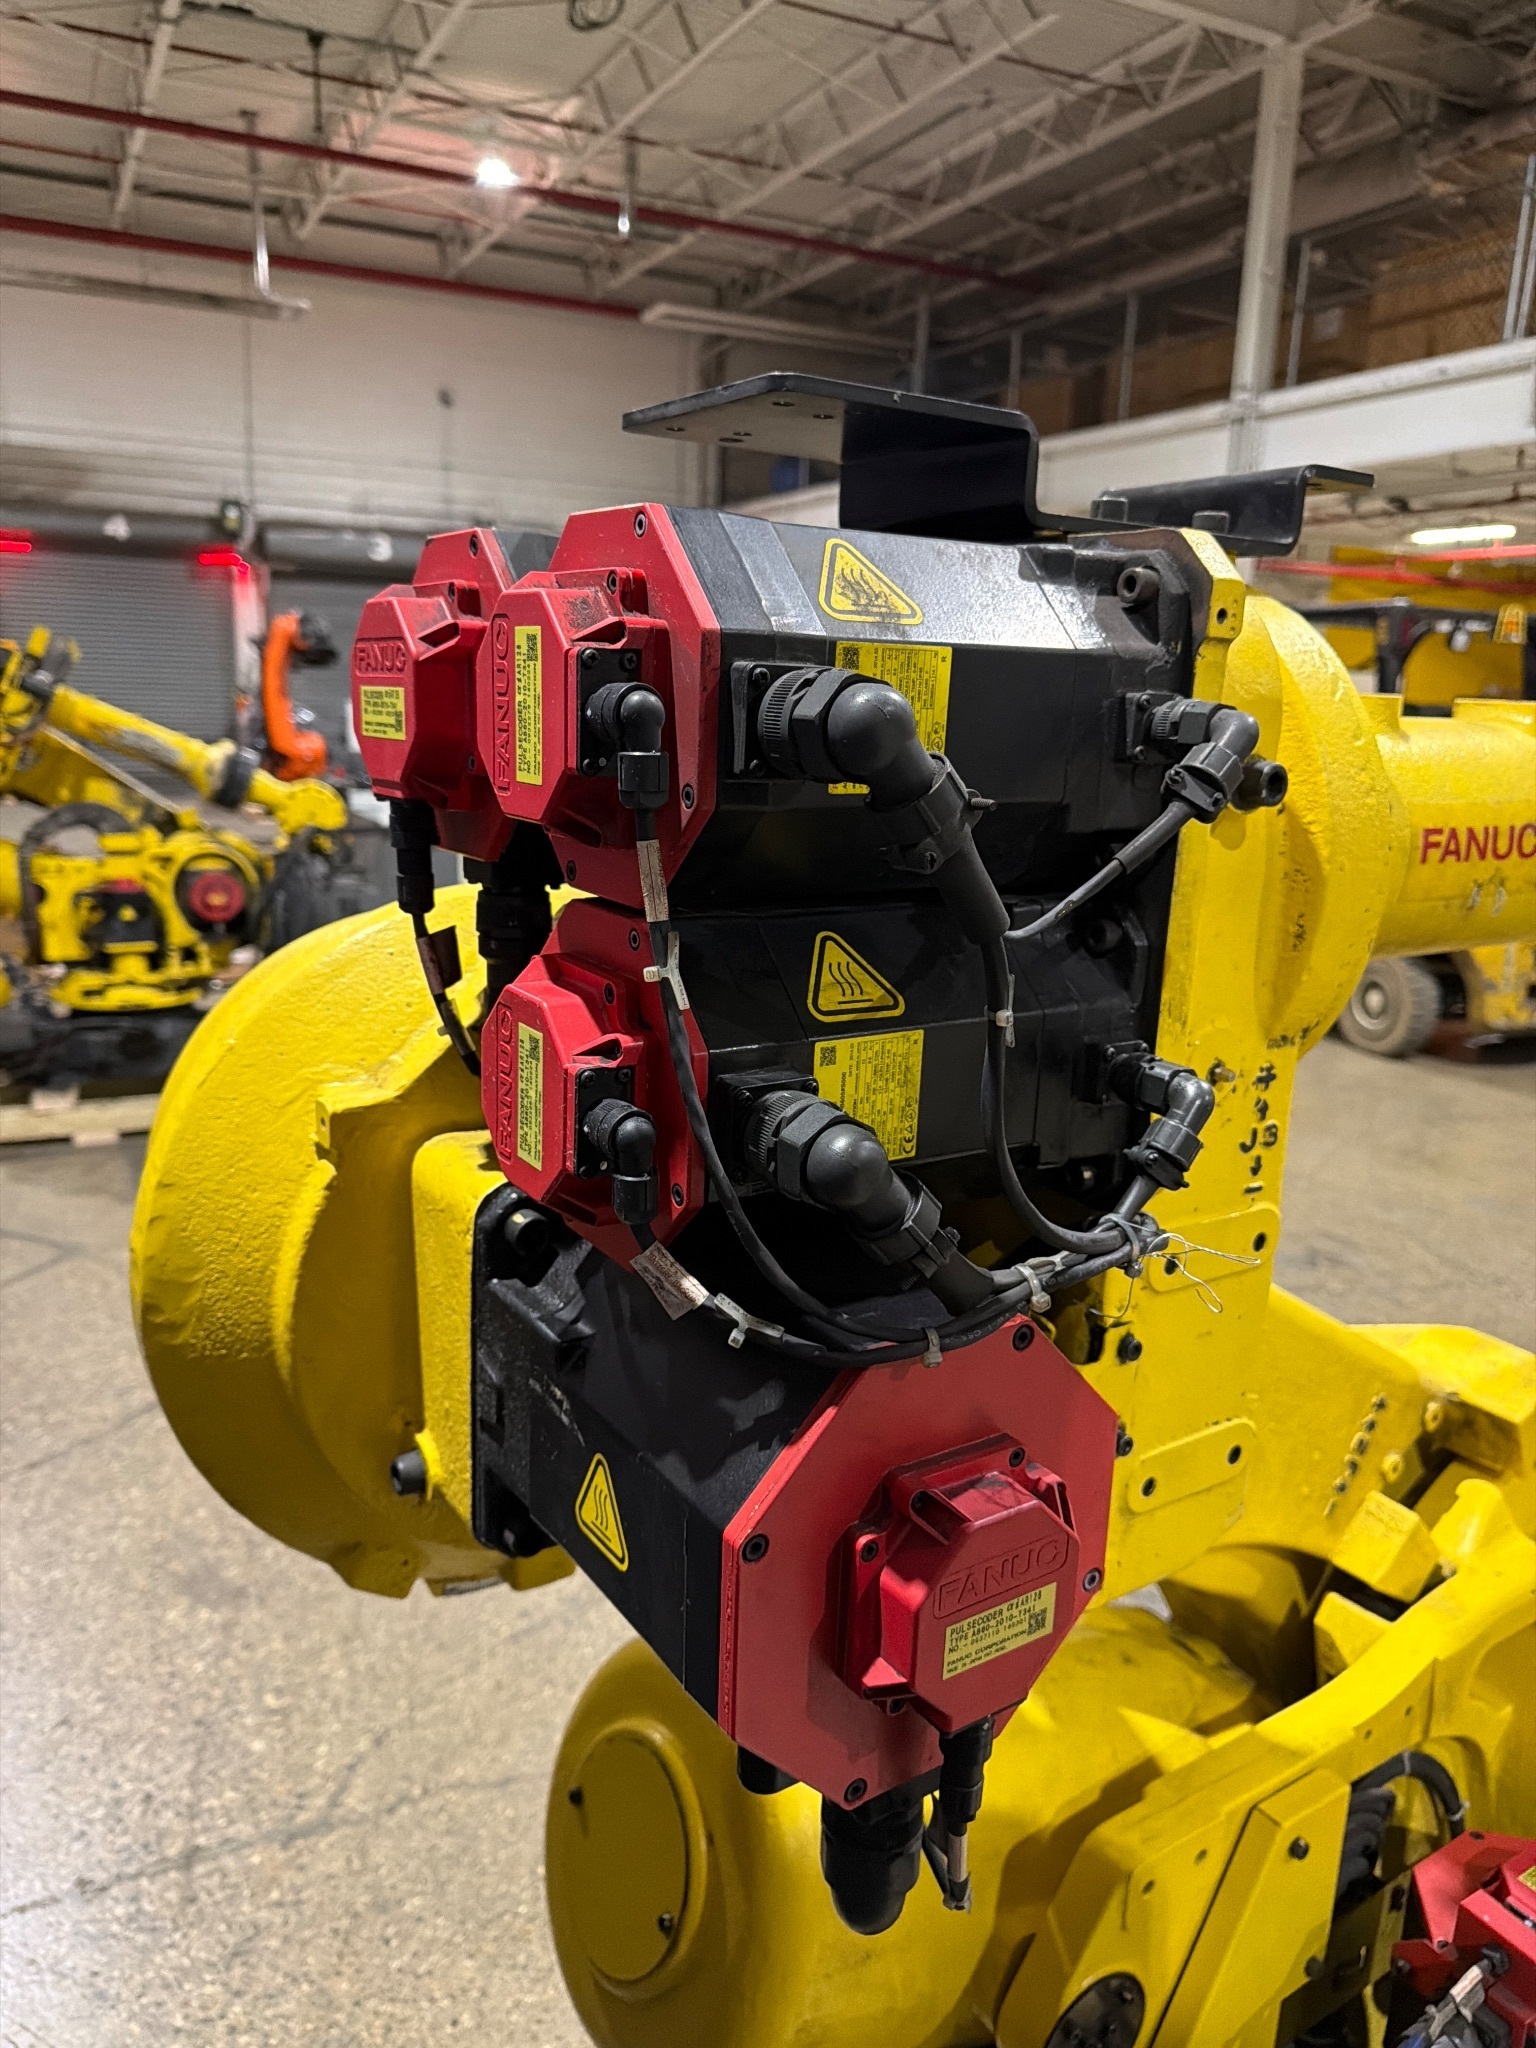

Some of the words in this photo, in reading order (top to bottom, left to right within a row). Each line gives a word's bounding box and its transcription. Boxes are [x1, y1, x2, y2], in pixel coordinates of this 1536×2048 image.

[355, 641, 407, 673] FANUC
[494, 617, 510, 793] FANUC
[1420, 823, 1536, 865] FANUC
[499, 1006, 514, 1161] FANUC
[902, 1134, 914, 1153] CE
[645, 1253, 672, 1280] BATTERY
[938, 1539, 1061, 1613] FANUC
[950, 1607, 1003, 1638] PULSECODER
[950, 1632, 968, 1646] TYPE
[974, 1628, 1026, 1655] CORPORATION
